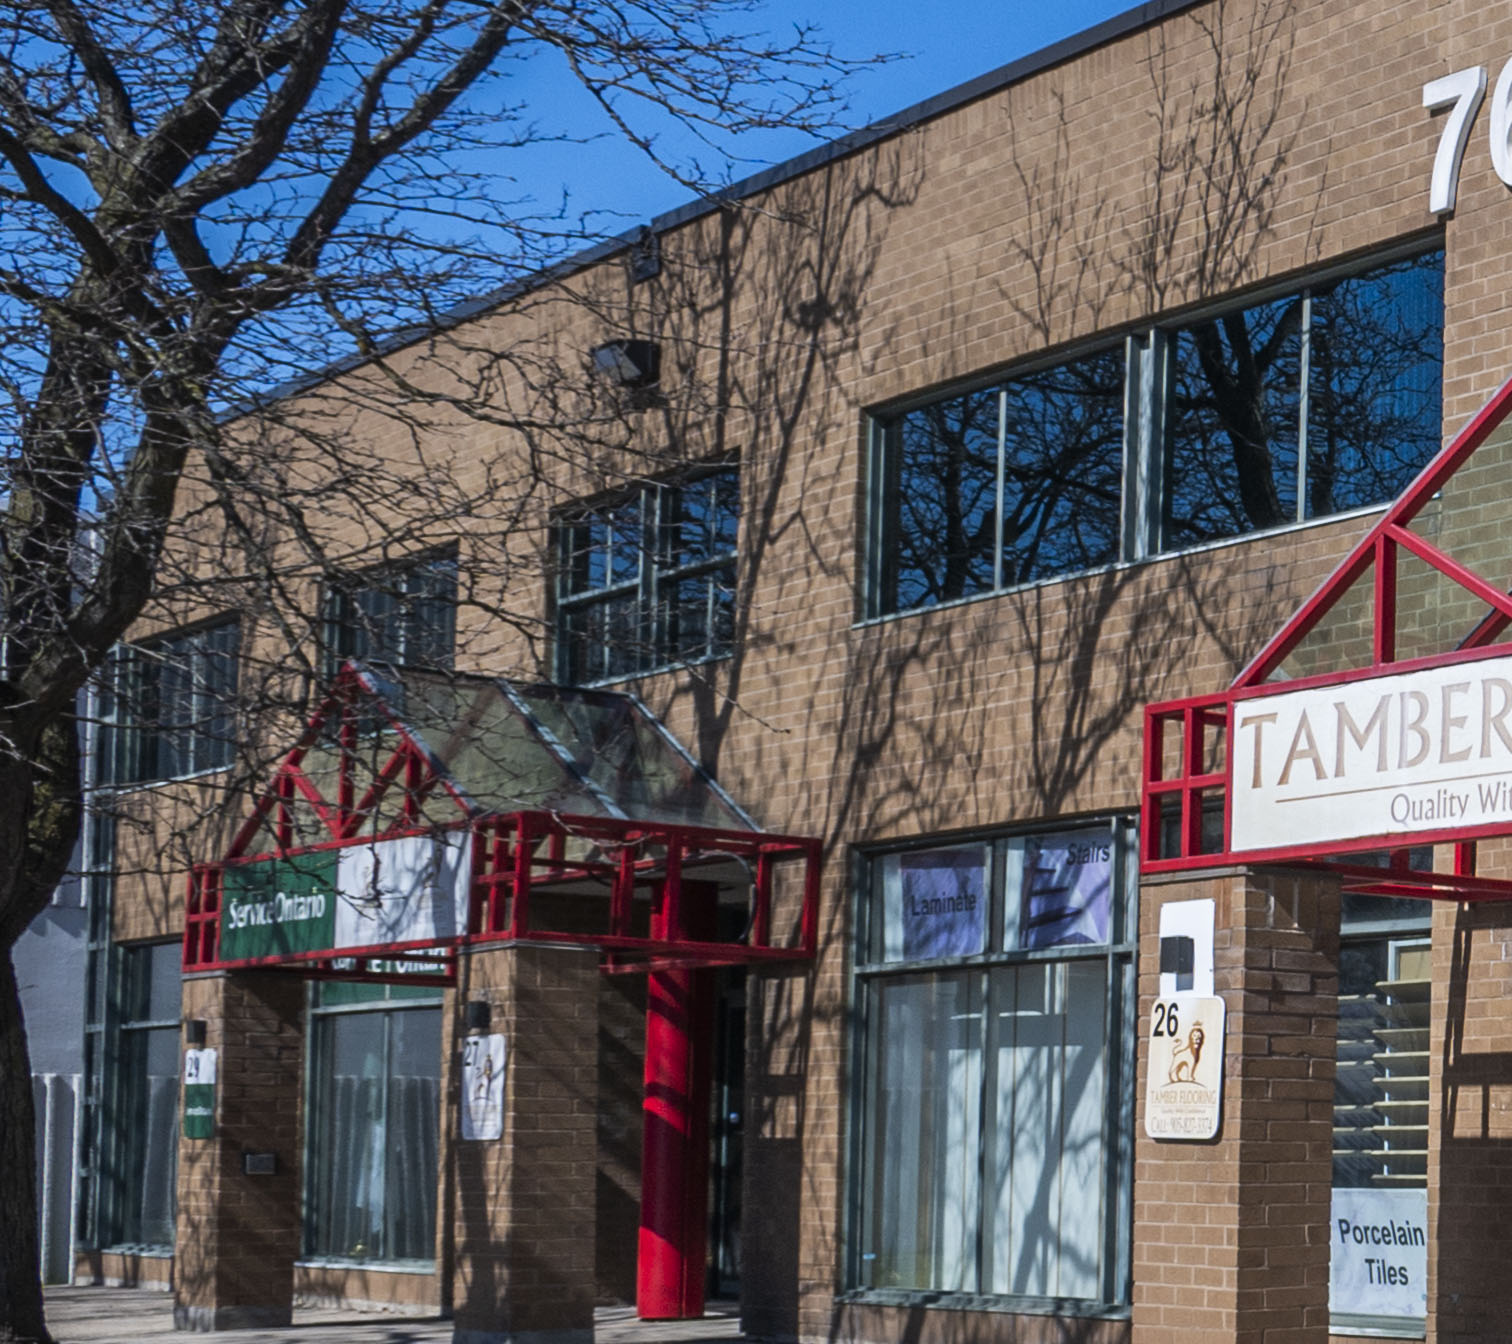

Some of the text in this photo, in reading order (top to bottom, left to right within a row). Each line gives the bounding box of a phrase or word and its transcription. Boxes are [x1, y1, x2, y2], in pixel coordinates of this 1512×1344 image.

[1390, 788, 1470, 827] Quality
[1066, 841, 1110, 866] Stairs
[911, 890, 977, 917] Laminate
[1153, 1002, 1179, 1038] 26
[465, 1040, 479, 1067] 27
[1338, 1217, 1425, 1248] Porcelain
[1364, 1256, 1409, 1286] Tiles
